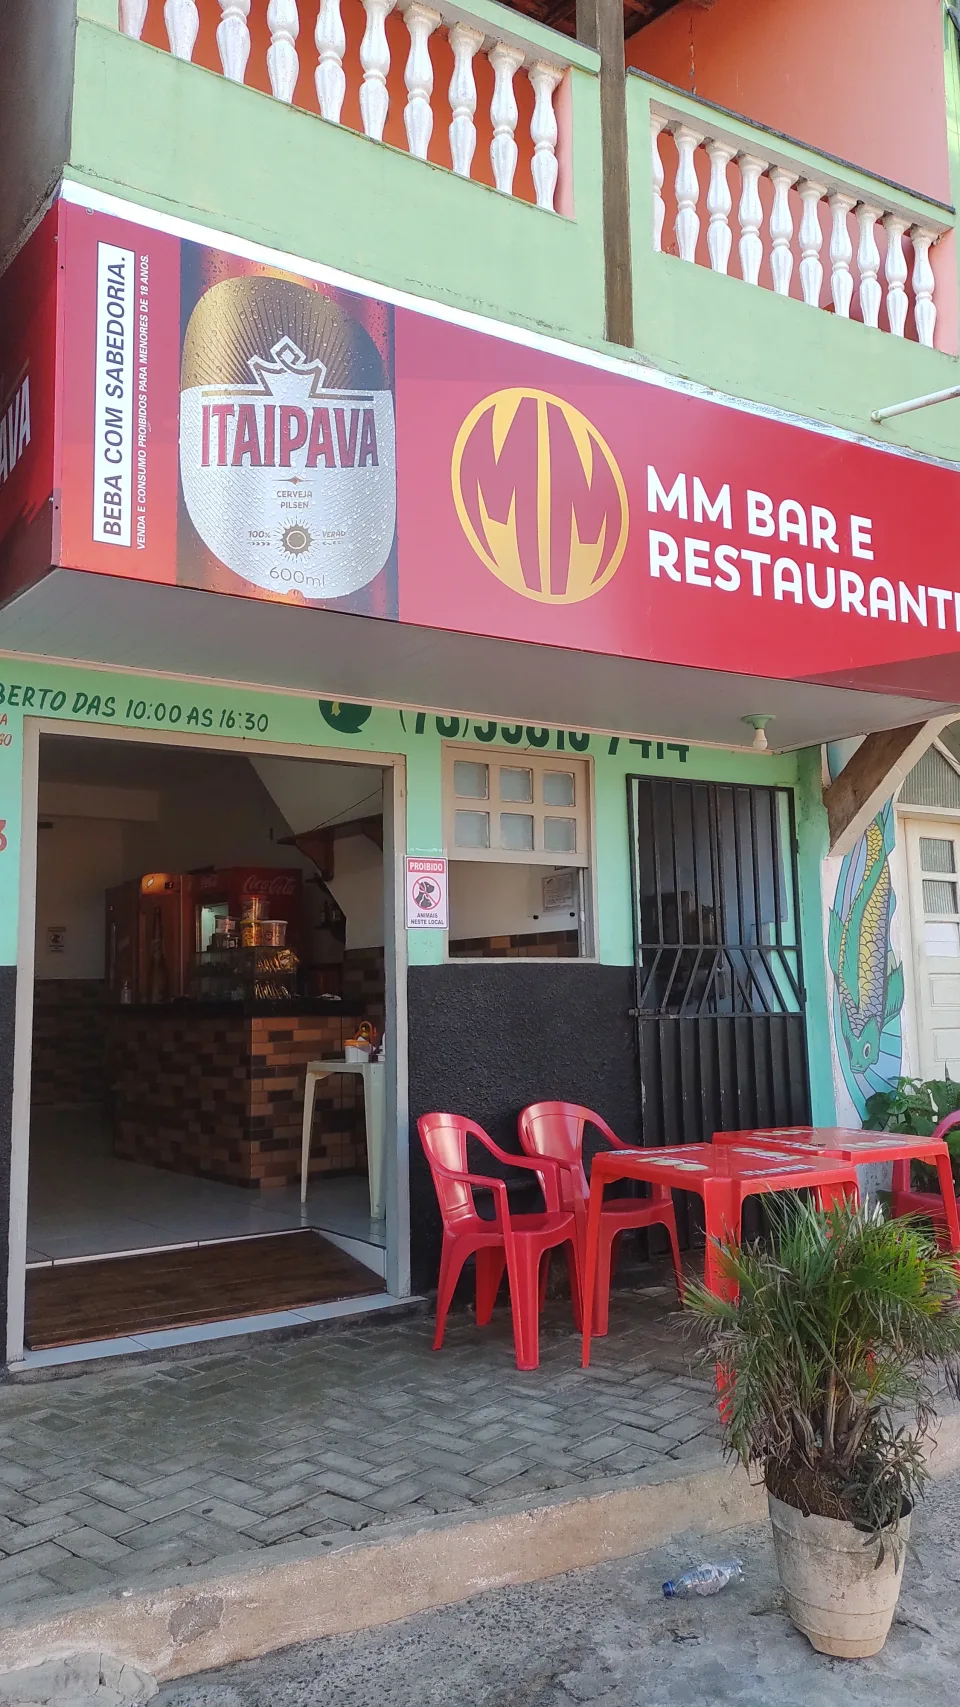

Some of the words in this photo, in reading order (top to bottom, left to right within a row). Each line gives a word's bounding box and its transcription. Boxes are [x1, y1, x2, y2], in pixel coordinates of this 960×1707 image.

[140, 254, 149, 285] ANOS.
[140, 285, 149, 296] 18
[140, 298, 149, 312] DE
[105, 257, 126, 399] SABEDORIA.
[139, 315, 149, 364] MENORES
[138, 367, 148, 392] PARA
[104, 407, 123, 464] COM
[138, 394, 147, 447] PROIBIDOS
[201, 403, 379, 469] ITAIPAVA
[137, 450, 147, 503] CONSUMO
[103, 475, 122, 536] BEBA
[137, 505, 146, 513] E
[276, 490, 313, 499] CERVEJA
[280, 501, 309, 509] PILSEN
[647, 464, 732, 530] MM
[746, 489, 840, 554] BAR
[850, 514, 875, 561] E
[136, 515, 146, 549] VENDA
[248, 530, 271, 538] 100%
[269, 566, 326, 587] 600ml
[648, 528, 960, 633] RESTAURANT
[72, 692, 116, 717] DAS
[126, 699, 182, 723] 10:00
[187, 706, 213, 727] AS
[219, 709, 269, 732] 16:30
[409, 861, 443, 872] PROIBIDO
